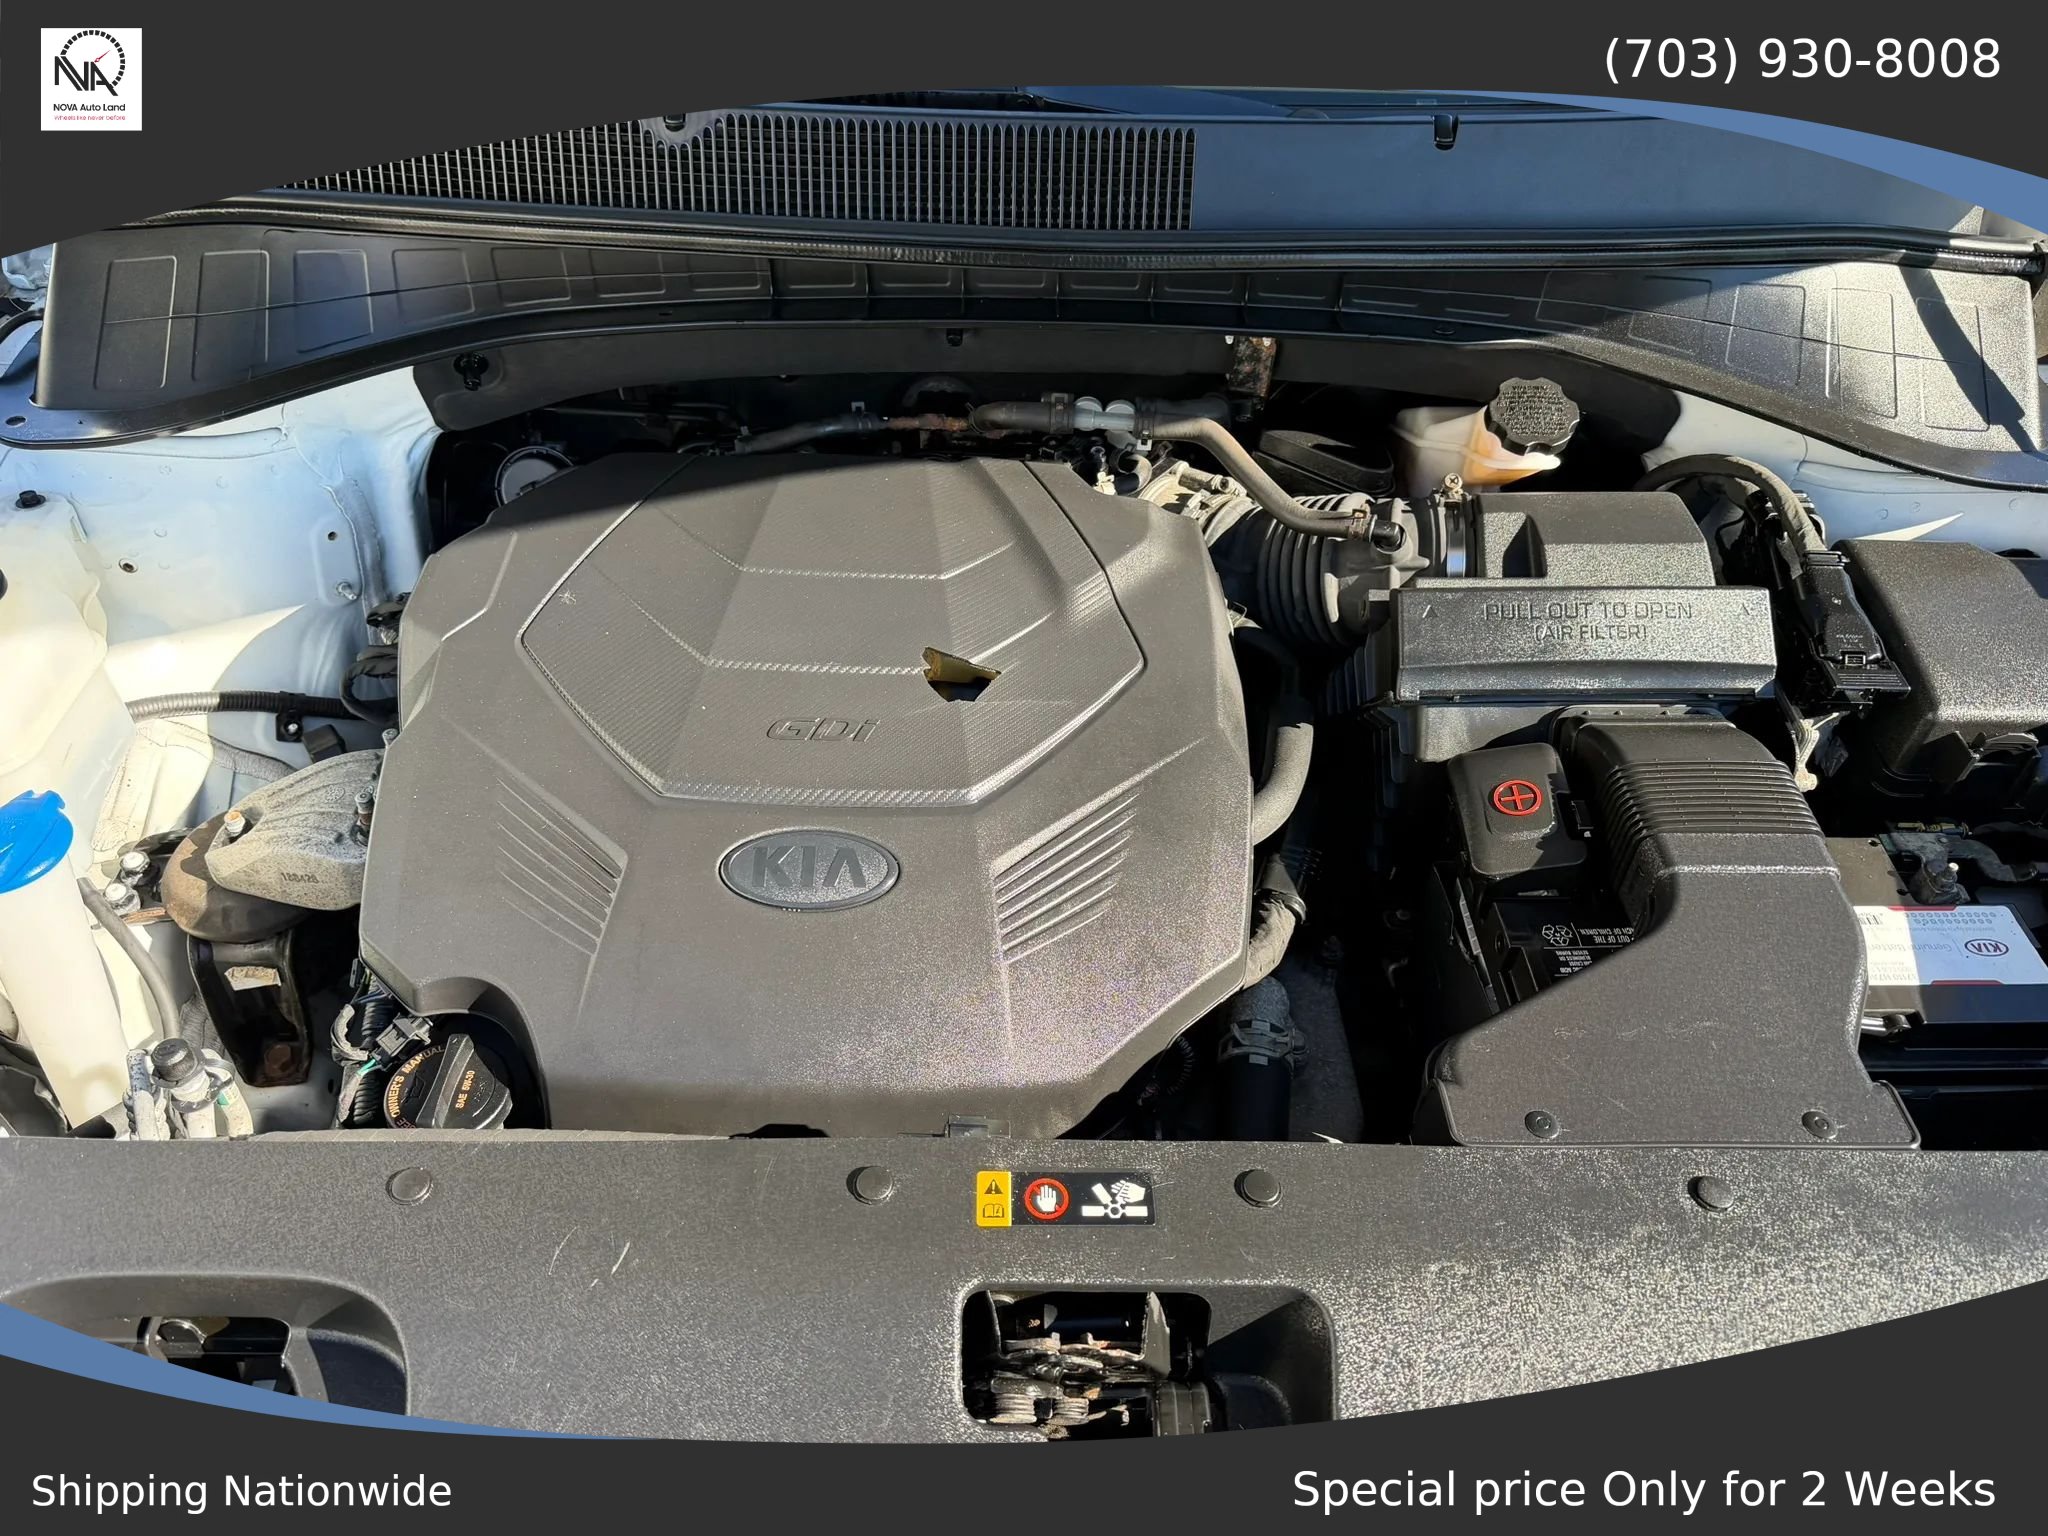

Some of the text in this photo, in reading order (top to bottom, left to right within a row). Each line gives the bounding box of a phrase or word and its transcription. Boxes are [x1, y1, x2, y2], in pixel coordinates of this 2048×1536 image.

[1484, 601, 1693, 620] PULL OUT TO OPEN
[1534, 624, 1648, 641] (AIR FILTER)
[751, 845, 868, 888] KIA
[1971, 942, 2001, 953] KIA
[387, 1075, 404, 1118] OWNER'S
[402, 1045, 445, 1074] MANUAL
[455, 1070, 475, 1109] SAE 5W-30
